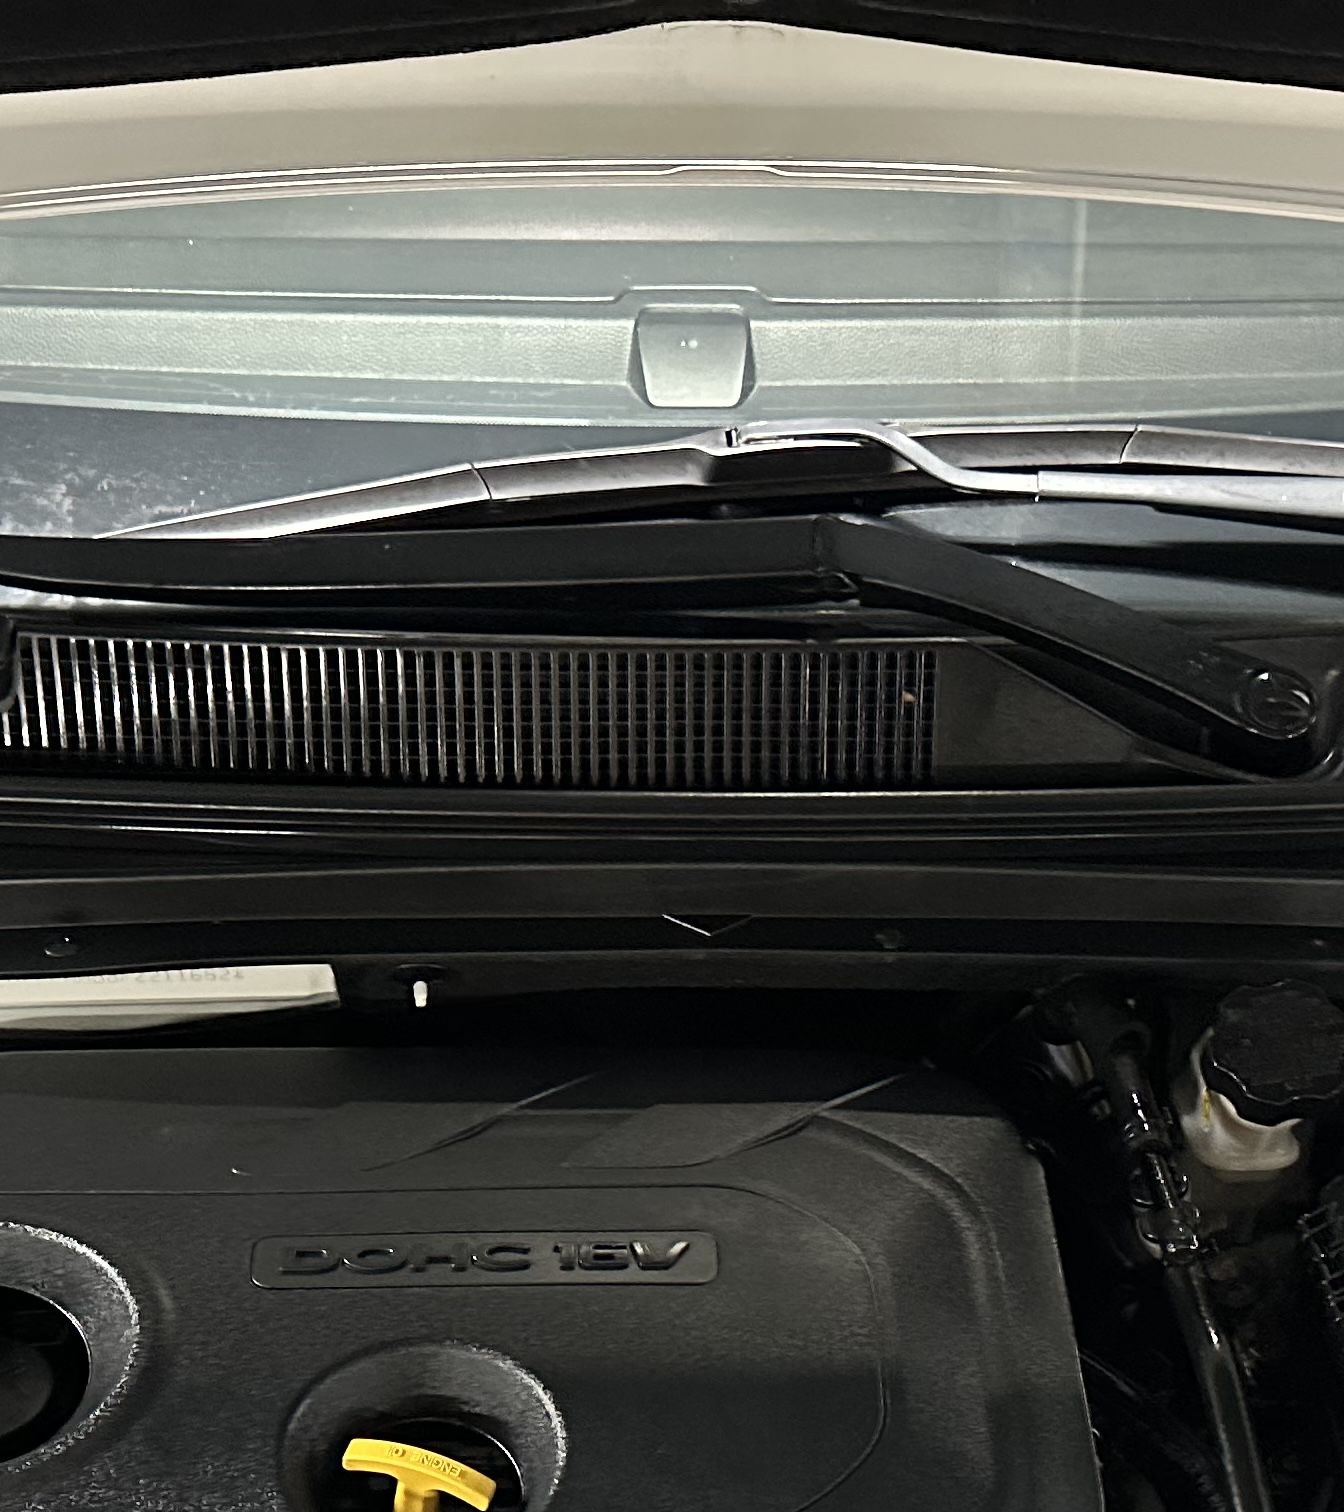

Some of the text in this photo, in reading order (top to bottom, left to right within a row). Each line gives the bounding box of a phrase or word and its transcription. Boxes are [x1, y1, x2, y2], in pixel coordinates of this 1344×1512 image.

[279, 1239, 691, 1275] DOHC 16V
[408, 1450, 463, 1479] ENGINE
